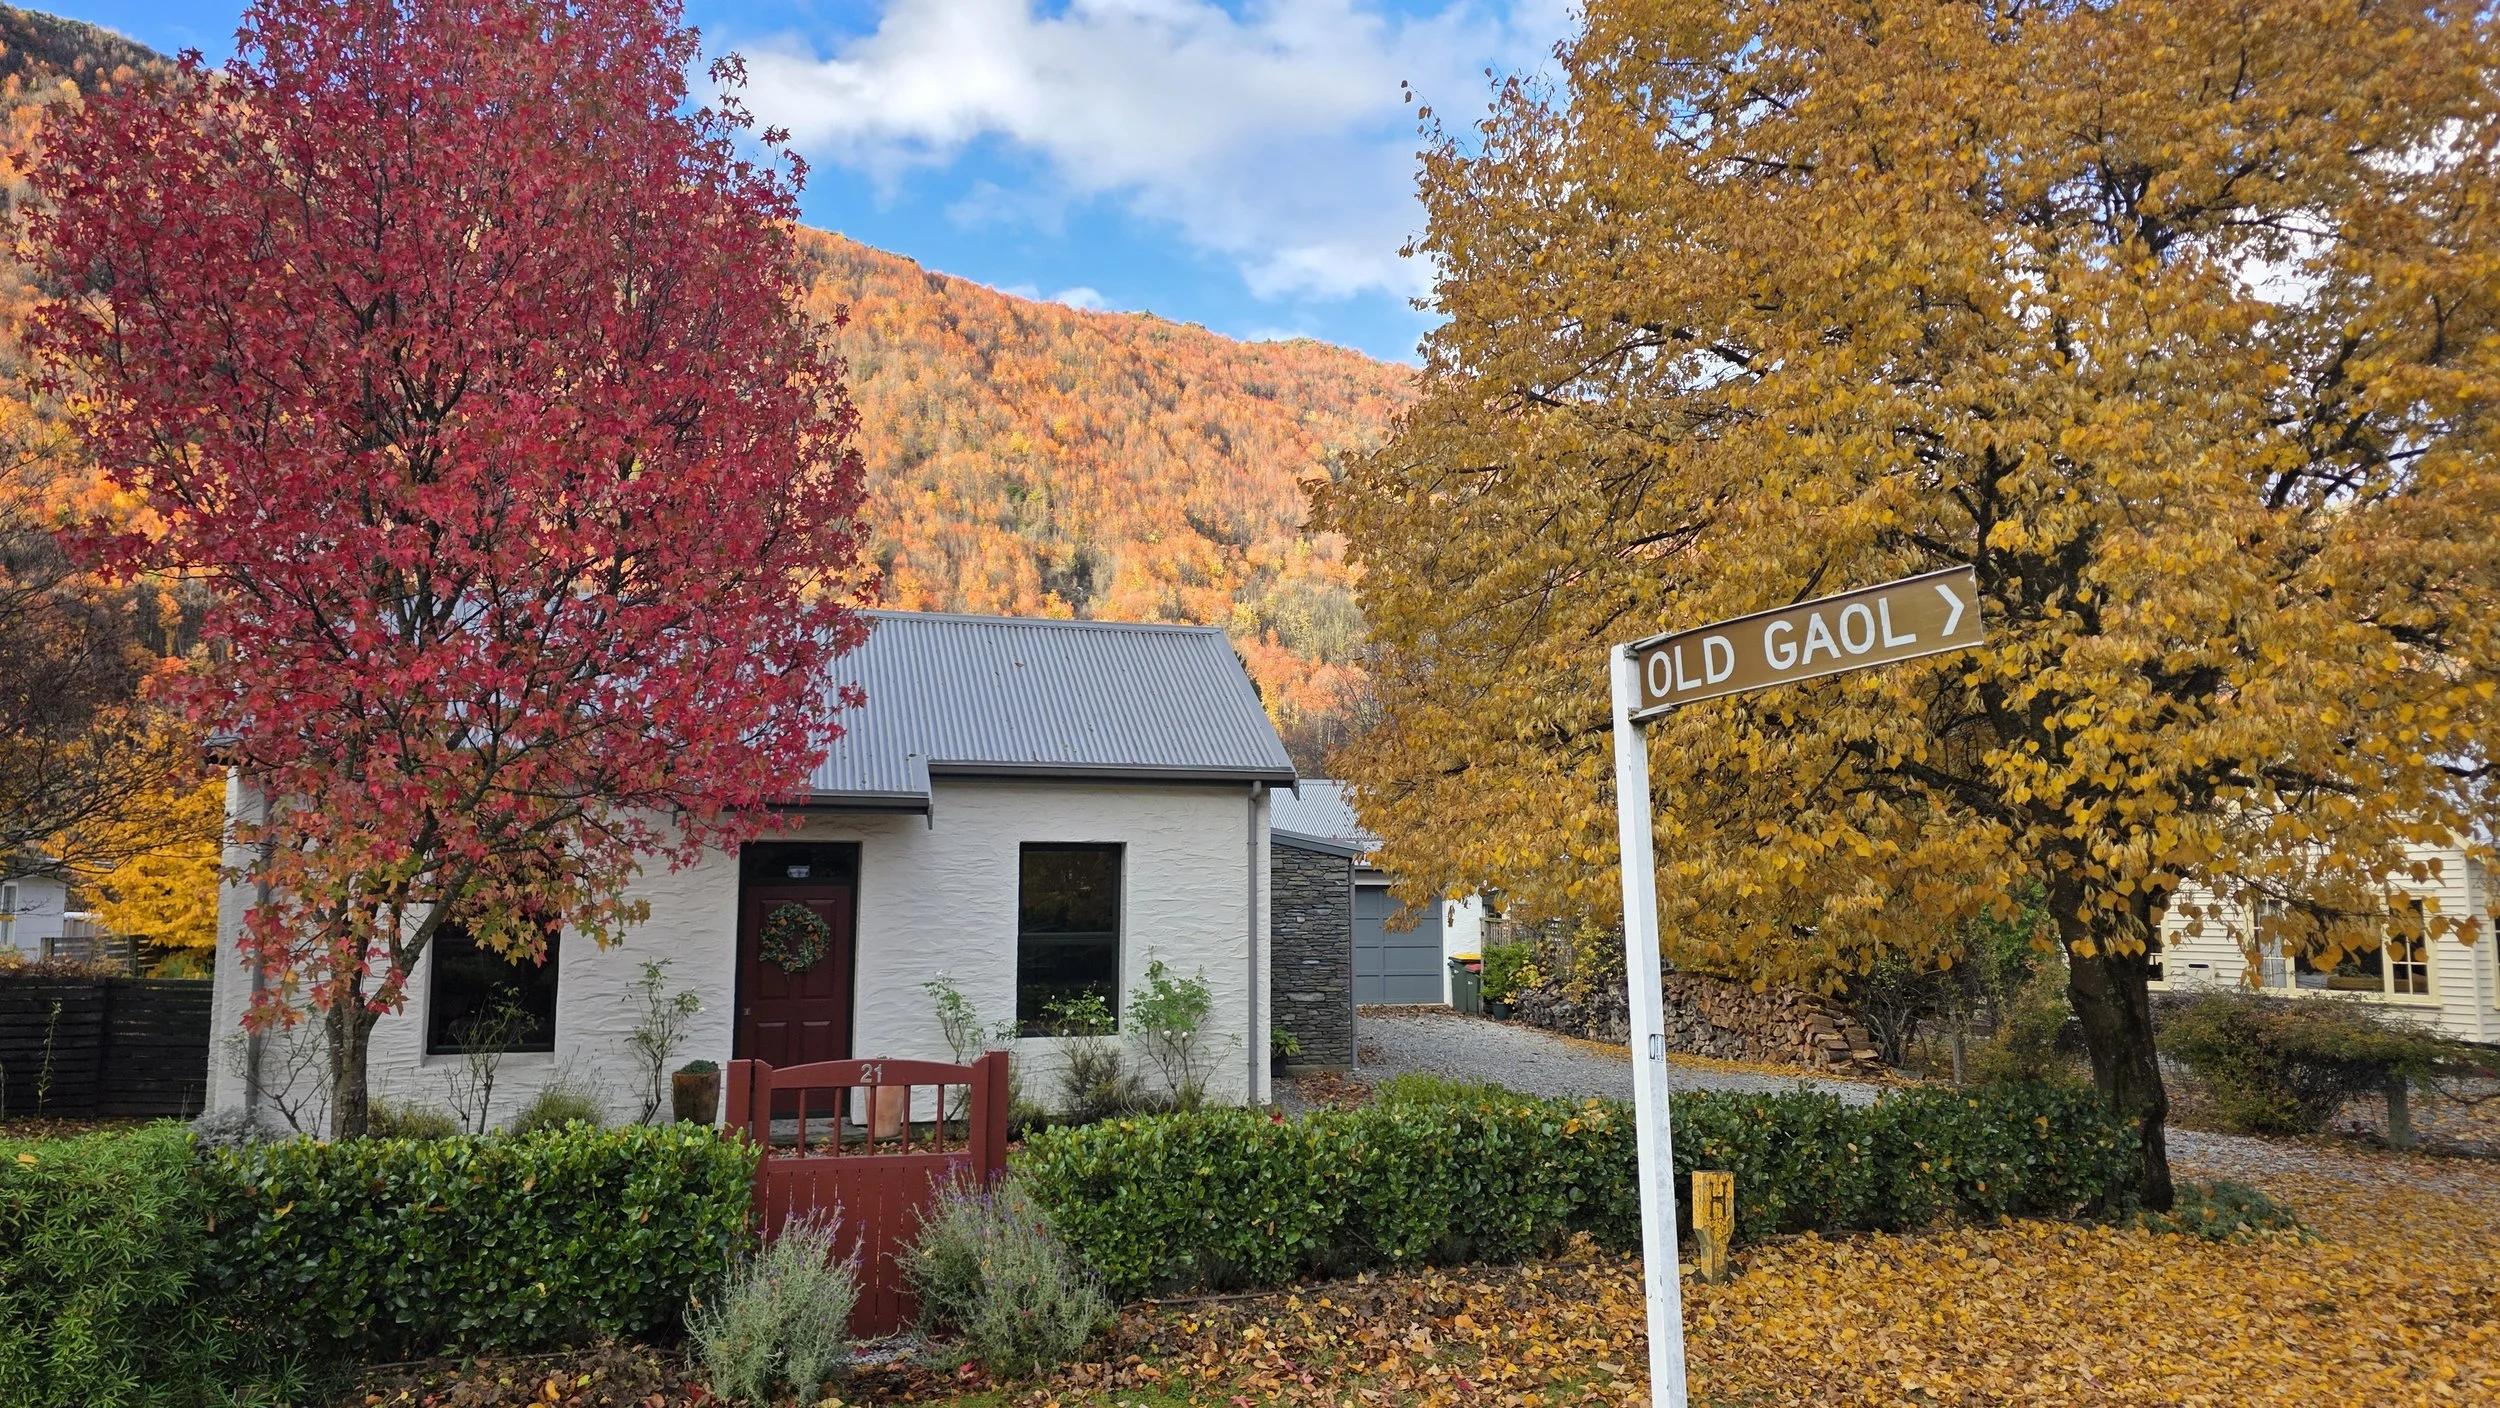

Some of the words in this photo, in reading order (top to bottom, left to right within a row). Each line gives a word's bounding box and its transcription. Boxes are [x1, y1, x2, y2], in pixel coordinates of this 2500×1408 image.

[1647, 635, 1735, 698] OLD
[1764, 597, 1917, 671] GAOL
[860, 1063, 882, 1083] 21
[1709, 1181, 1728, 1220] H
